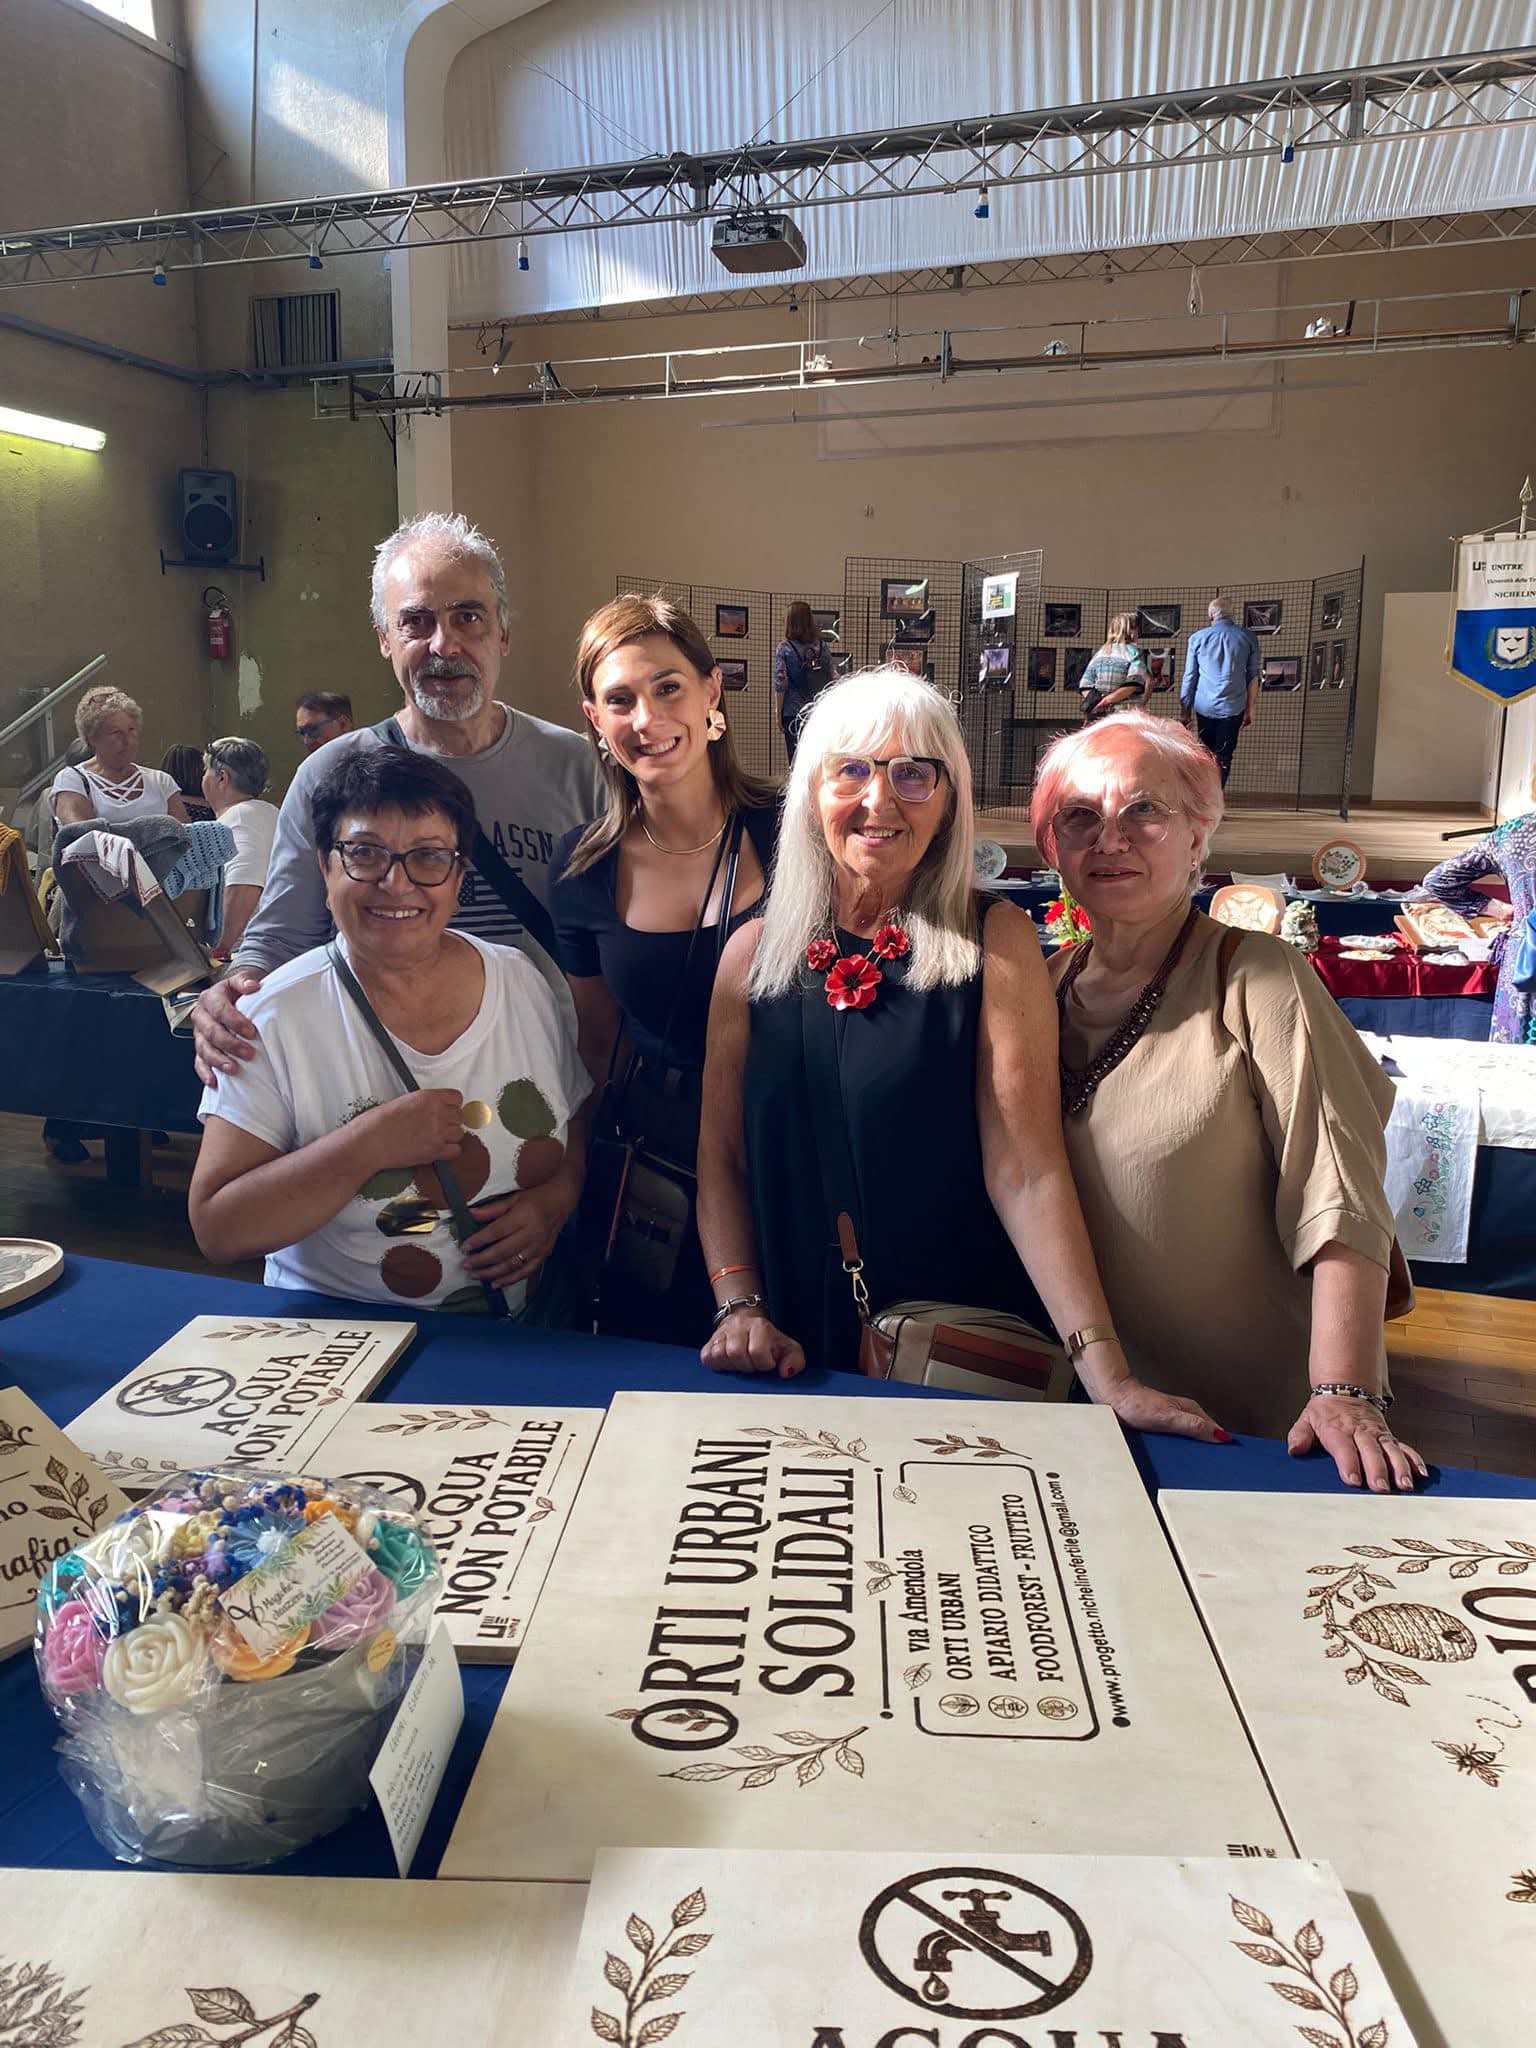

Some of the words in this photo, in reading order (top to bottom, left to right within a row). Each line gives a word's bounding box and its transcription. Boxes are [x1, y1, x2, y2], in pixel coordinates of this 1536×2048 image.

[1491, 563, 1524, 571] UNITRE
[494, 821, 553, 865] ASSN
[200, 1353, 310, 1437] ACQUA
[219, 1423, 293, 1470] NON
[265, 1330, 373, 1417] POTABILE
[470, 1420, 564, 1537] POTABILE
[663, 1438, 772, 1586] URBANI
[968, 1523, 1004, 1603] DIDATTICO
[1001, 1493, 1037, 1561] FRUTTETO
[433, 1547, 510, 1616] NON
[758, 1467, 856, 1698] SOLIDALI
[897, 1548, 929, 1624] Amendola
[937, 1572, 967, 1632] URBANI
[1047, 1480, 1129, 1717] www.progetto.nichelinofertile@gmail.com
[908, 1628, 931, 1654] via
[943, 1636, 973, 1681] ORTI
[979, 1607, 1018, 1682] APIARIO
[1017, 1573, 1065, 1682] FOODFOREST
[630, 1606, 751, 1751] ORTI
